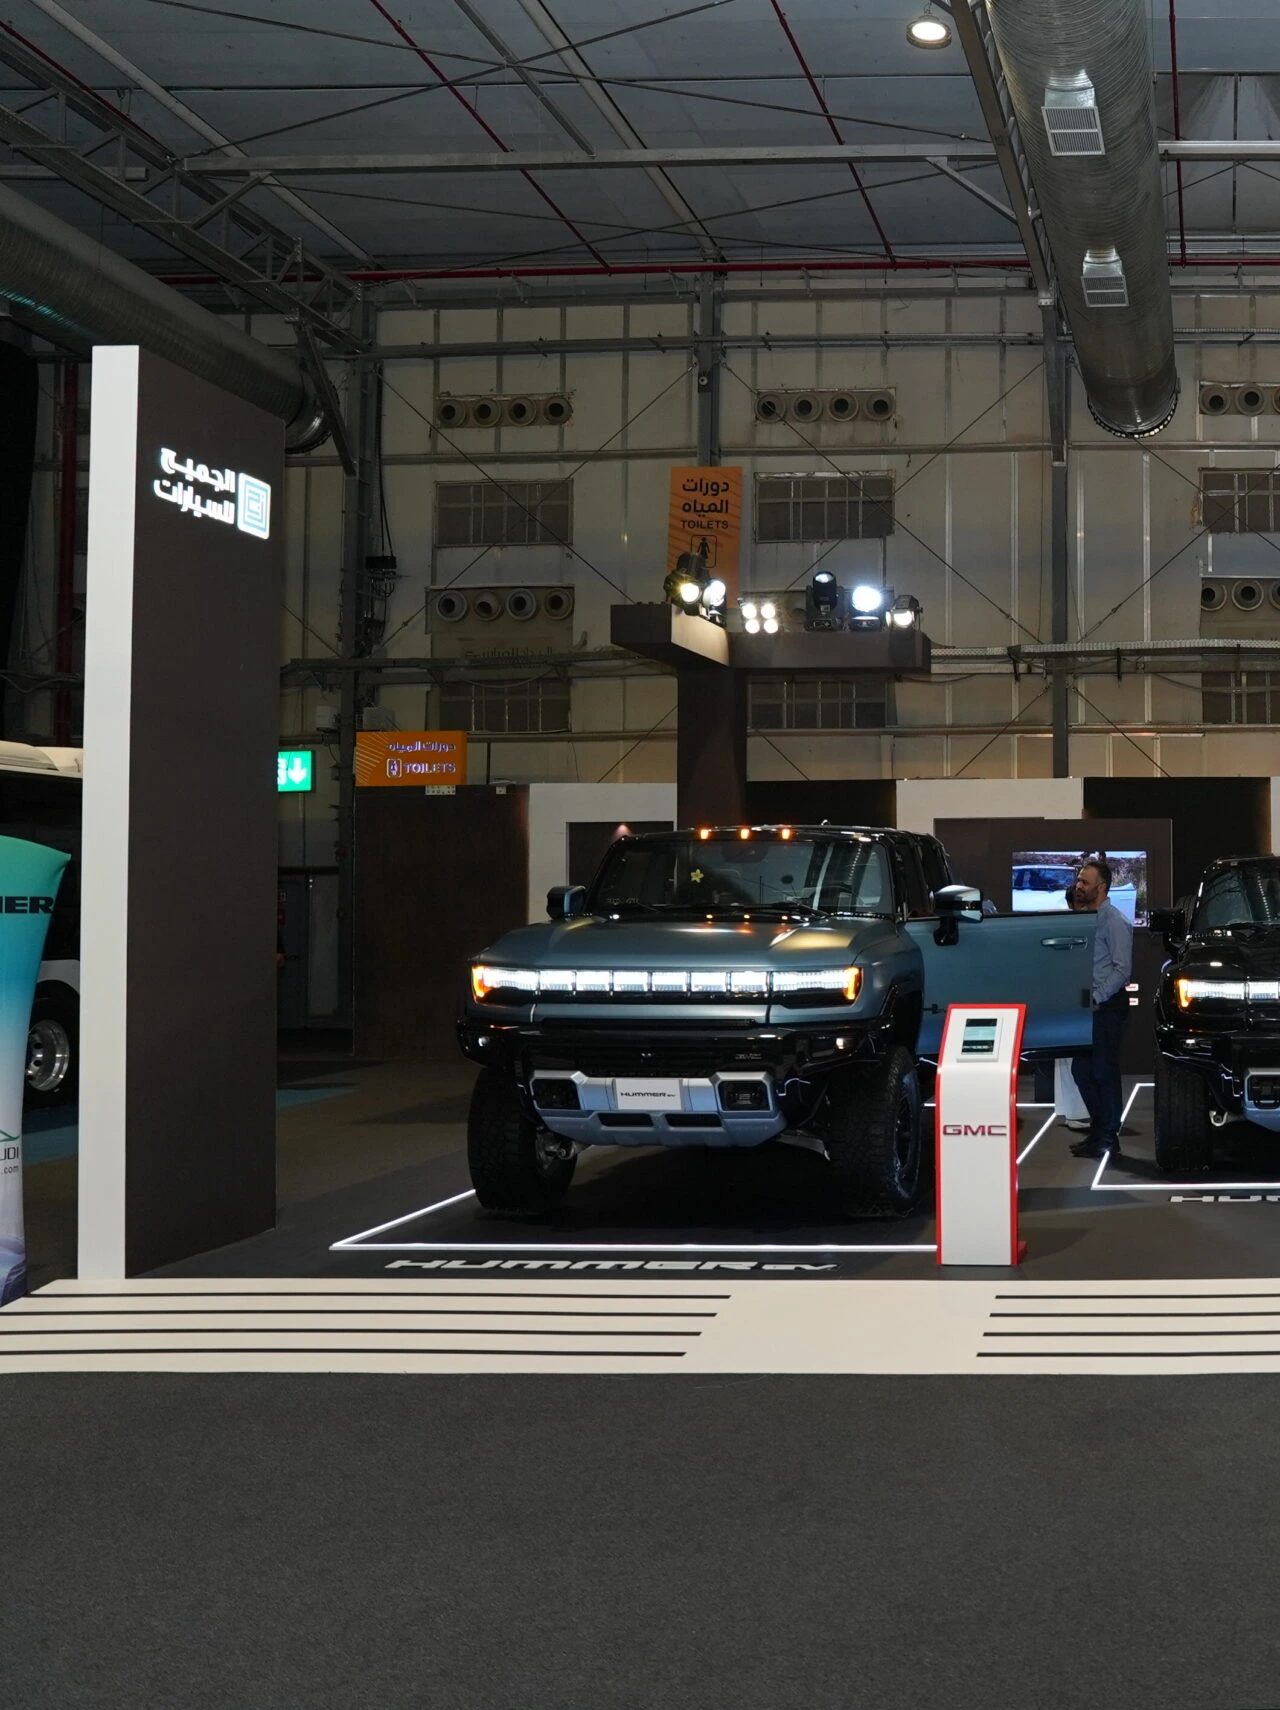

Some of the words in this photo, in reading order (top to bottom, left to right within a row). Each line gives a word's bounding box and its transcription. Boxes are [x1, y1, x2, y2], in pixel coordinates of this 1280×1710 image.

[161, 447, 236, 493] الجميح
[682, 478, 730, 497] دورات
[682, 499, 729, 518] المياه
[681, 520, 729, 529] TOILETS
[388, 741, 421, 754] المياه
[422, 741, 457, 753] دورات
[404, 763, 457, 773] TOILETS
[0, 896, 54, 914] ER
[943, 1124, 1007, 1136] GMC
[384, 1259, 758, 1271] HUMMER
